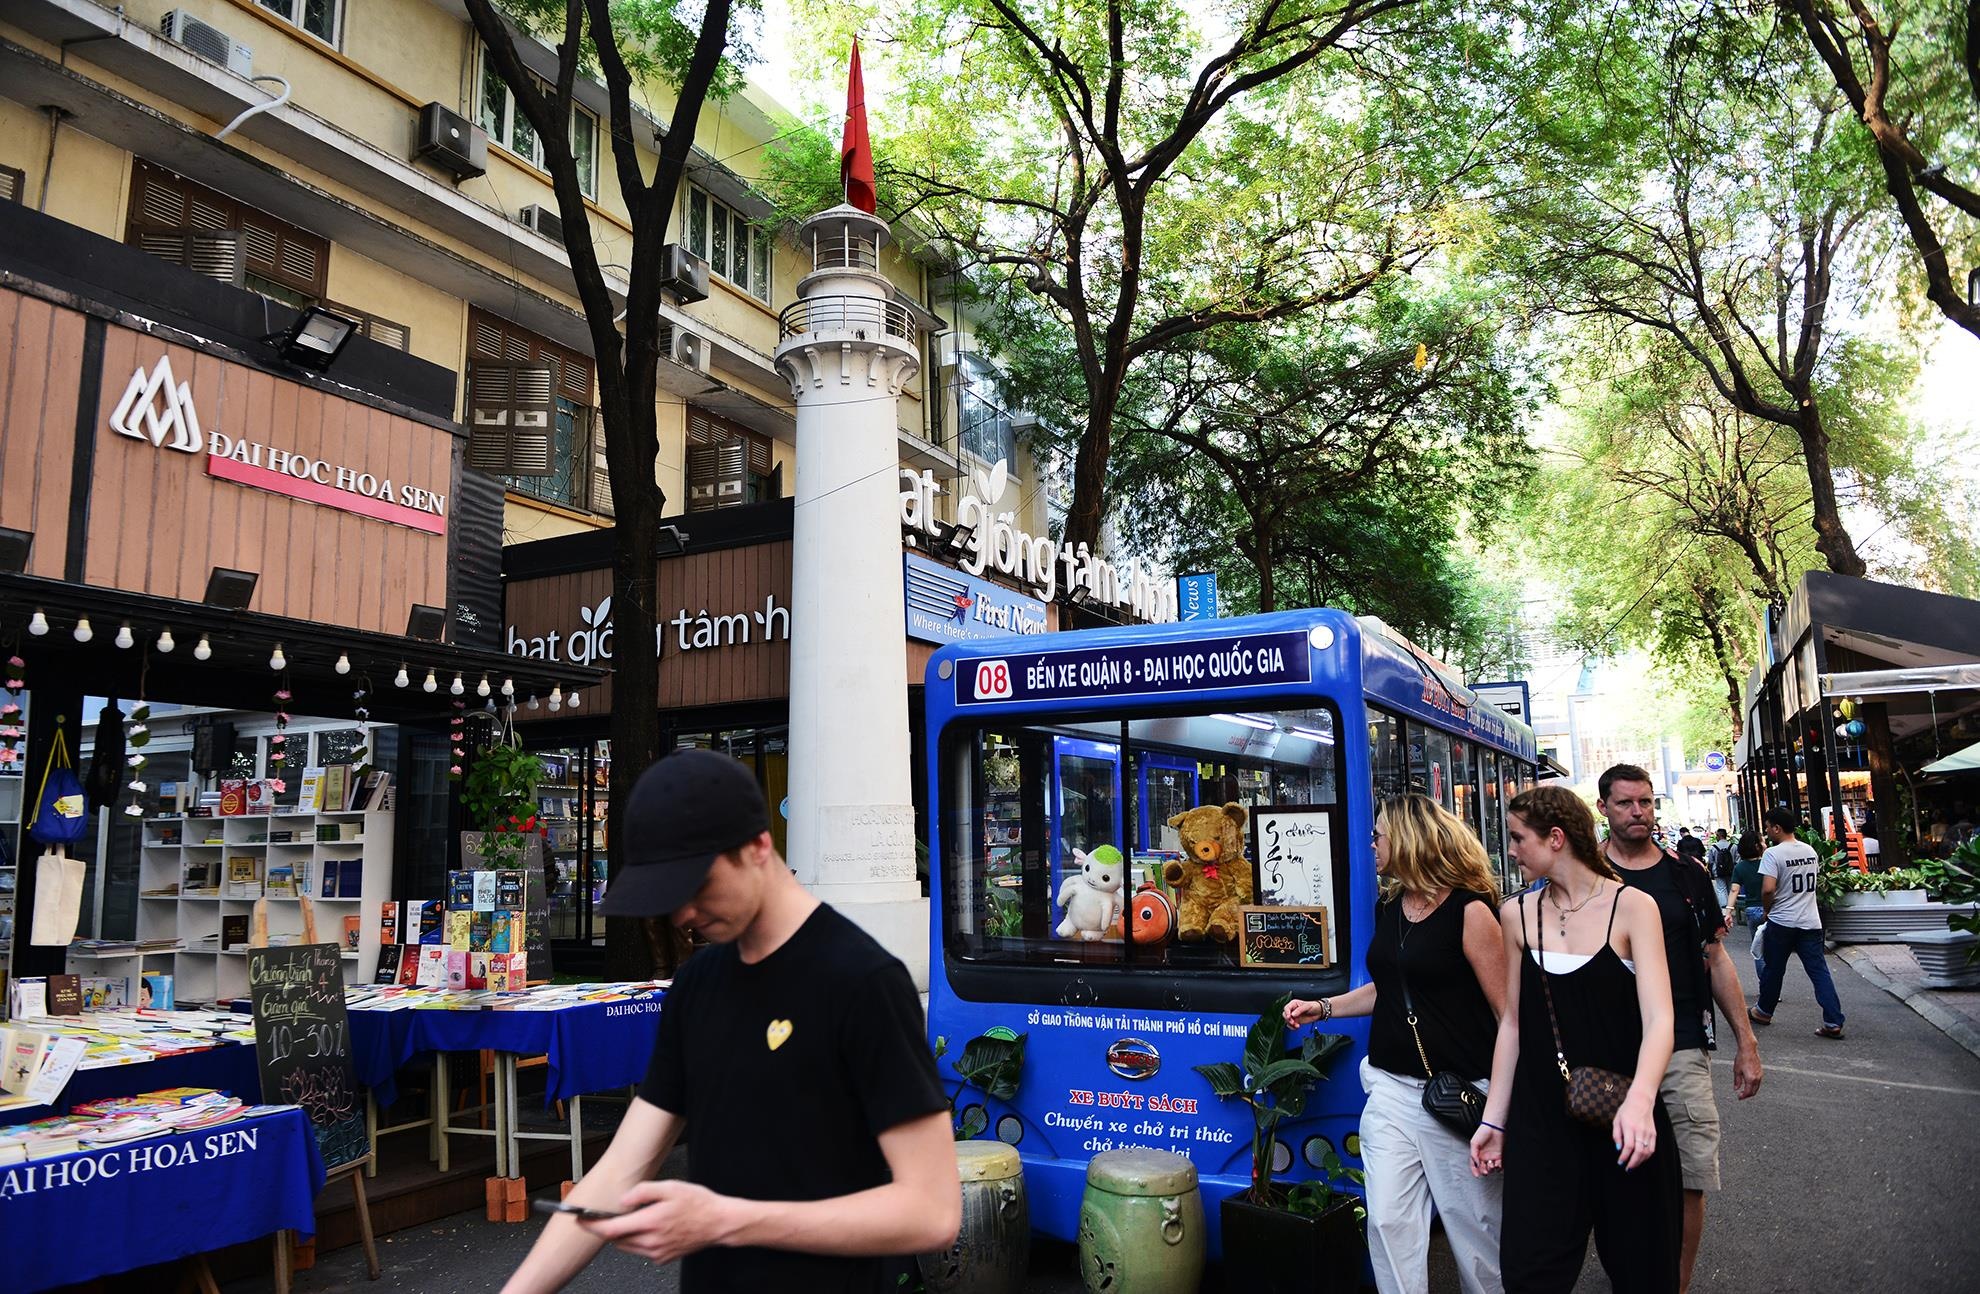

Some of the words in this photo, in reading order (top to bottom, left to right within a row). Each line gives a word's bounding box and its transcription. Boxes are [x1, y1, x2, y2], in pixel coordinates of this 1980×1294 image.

[335, 466, 396, 503] HOA
[400, 485, 446, 516] SEN
[899, 468, 942, 547] ạt
[1060, 541, 1121, 608] tâm
[671, 608, 749, 650] tâm
[913, 612, 941, 633] Where
[943, 622, 971, 640] there's
[973, 592, 1010, 629] First
[1010, 604, 1048, 637] News
[978, 665, 1007, 695] 08
[1027, 656, 1055, 690] BẾN
[1058, 664, 1076, 688] XE
[1080, 656, 1121, 694] QUẬN
[1124, 661, 1132, 685] 8
[1144, 656, 1169, 686] ĐẠI
[1173, 654, 1205, 685] HỌC
[1209, 641, 1253, 678] QUỐC
[1257, 647, 1285, 674] GIA
[645, 1003, 662, 1013] HOA
[1028, 1010, 1040, 1025] SỞ
[1042, 1014, 1062, 1027] GIAO
[1095, 1014, 1113, 1030] VẬN
[1115, 1015, 1131, 1030] TẢI
[1132, 1016, 1163, 1033] THÀNH
[1165, 1017, 1185, 1034] PHỐ
[1187, 1017, 1201, 1035] HỒ
[1204, 1021, 1221, 1036] CHÍ
[1223, 1025, 1248, 1038] MINH
[1069, 1089, 1094, 1105] XE
[1098, 1090, 1144, 1109] BUÝT
[1149, 1093, 1198, 1114] SÁCH
[1044, 1111, 1103, 1132] Chuyến
[1108, 1121, 1128, 1133] xe
[1133, 1121, 1164, 1137] chở
[1169, 1125, 1189, 1139] tri
[1195, 1126, 1233, 1144] thức
[1083, 1137, 1113, 1152] chở
[0, 1167, 36, 1200] ẠI
[43, 1152, 120, 1189] HỌC
[128, 1140, 199, 1174] HOA
[204, 1128, 259, 1160] SEN
